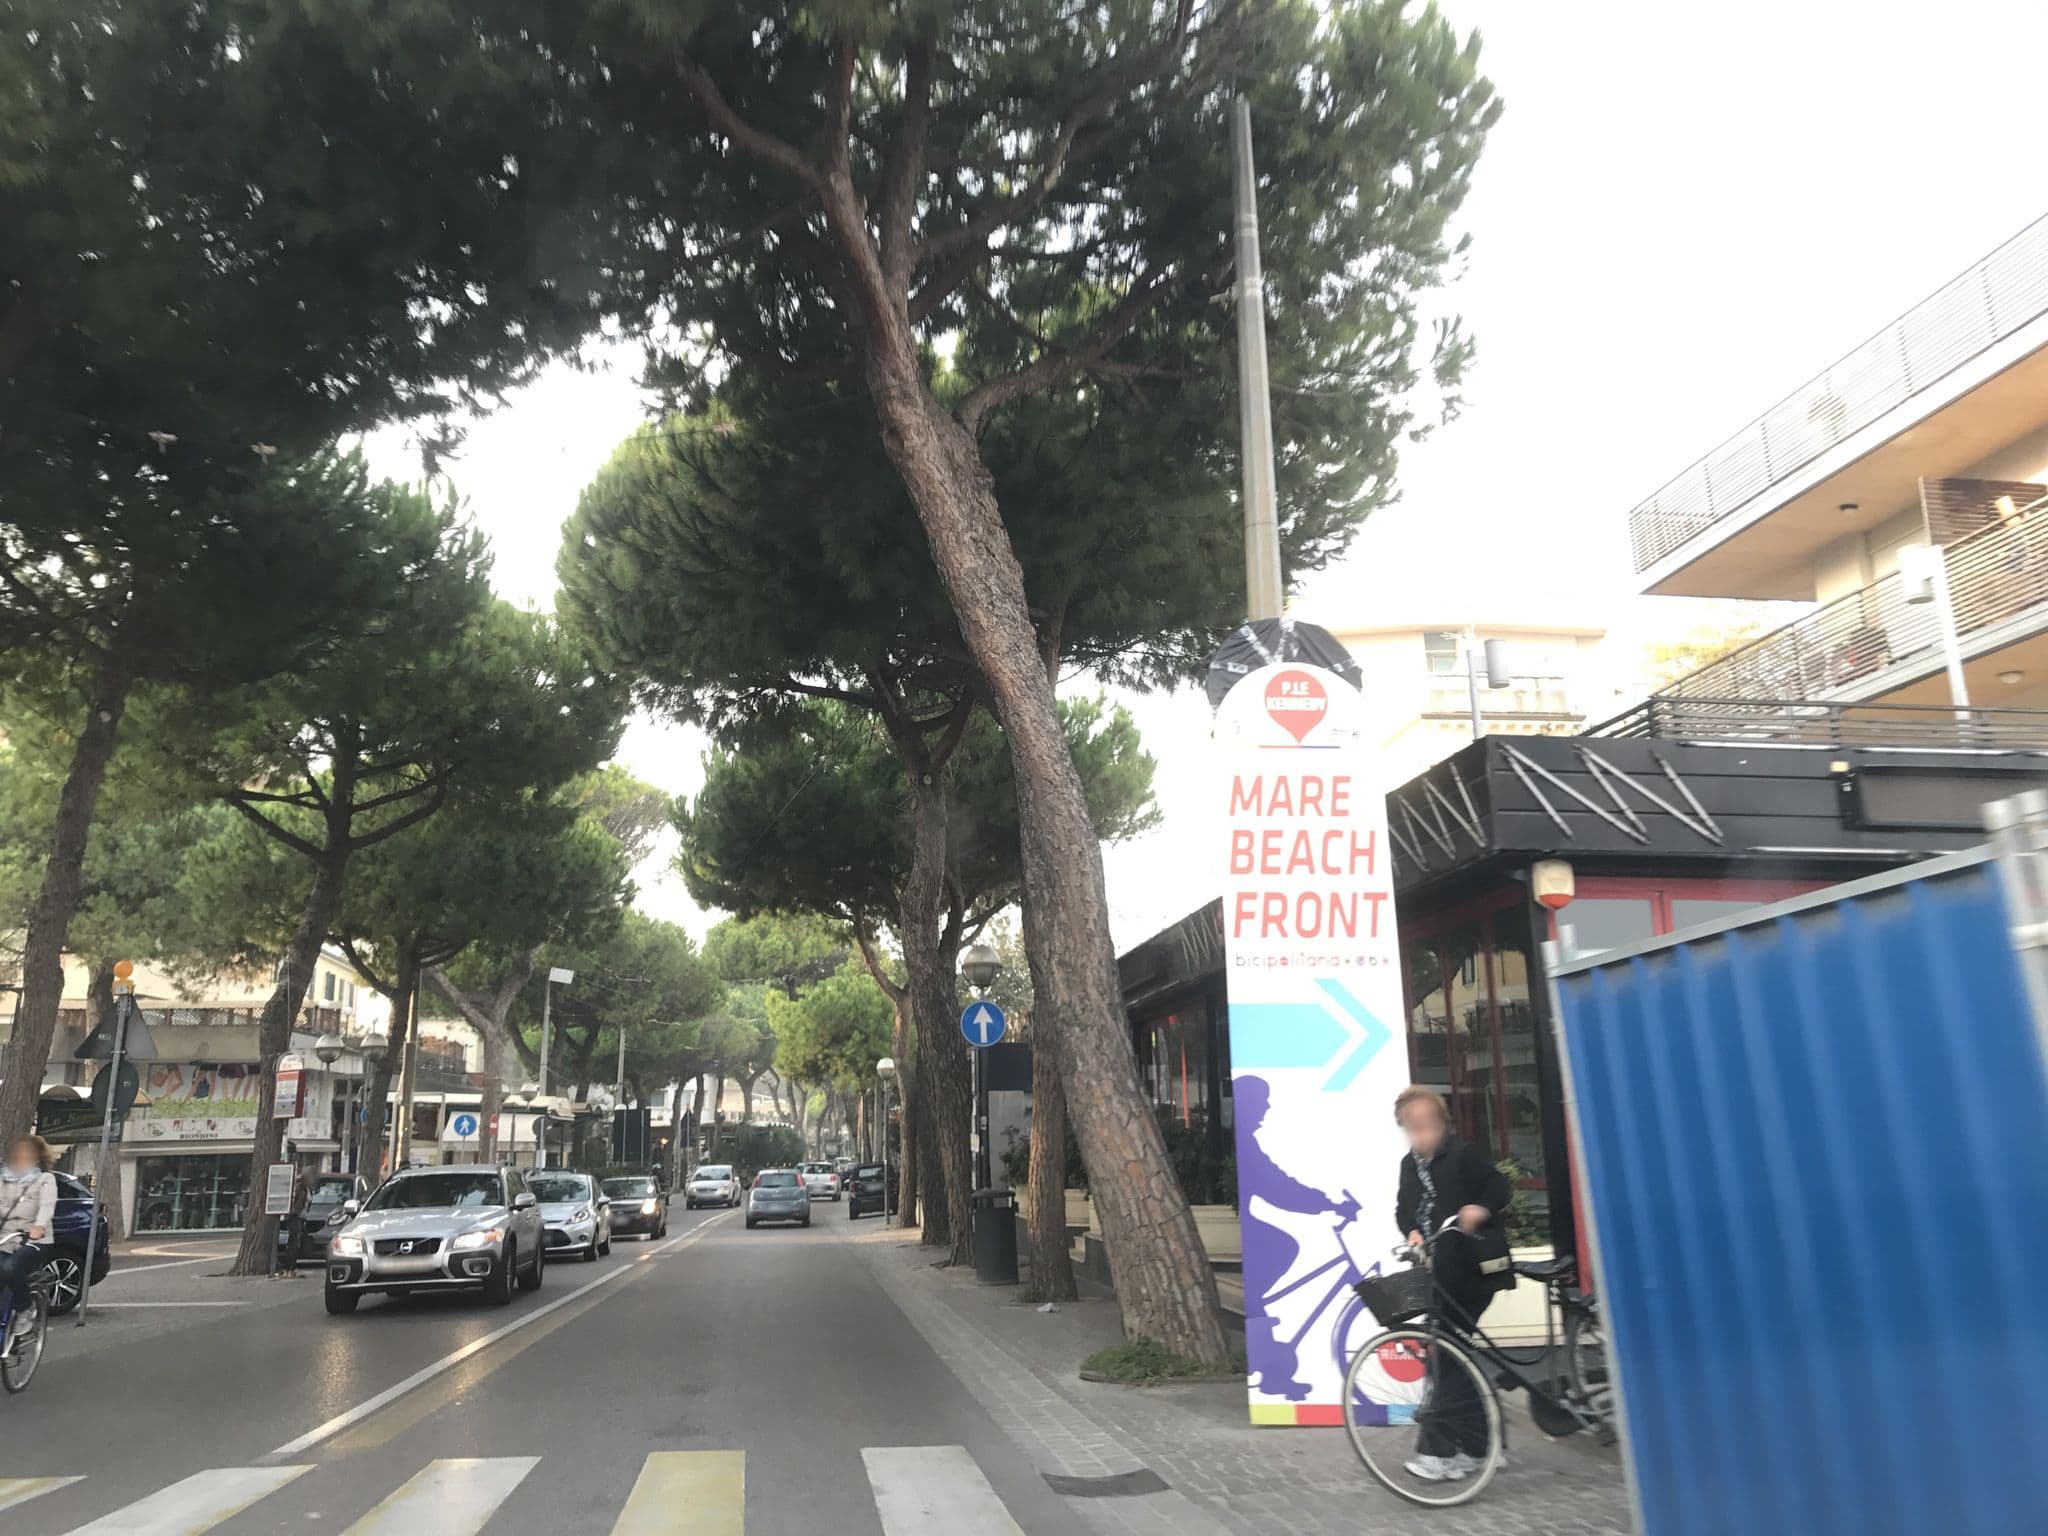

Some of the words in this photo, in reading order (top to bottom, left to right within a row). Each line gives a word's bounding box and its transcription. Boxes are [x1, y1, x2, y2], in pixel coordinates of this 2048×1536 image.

[1229, 775, 1352, 817] MARE
[1230, 829, 1376, 875] BEACH
[1233, 890, 1388, 939] FRONT
